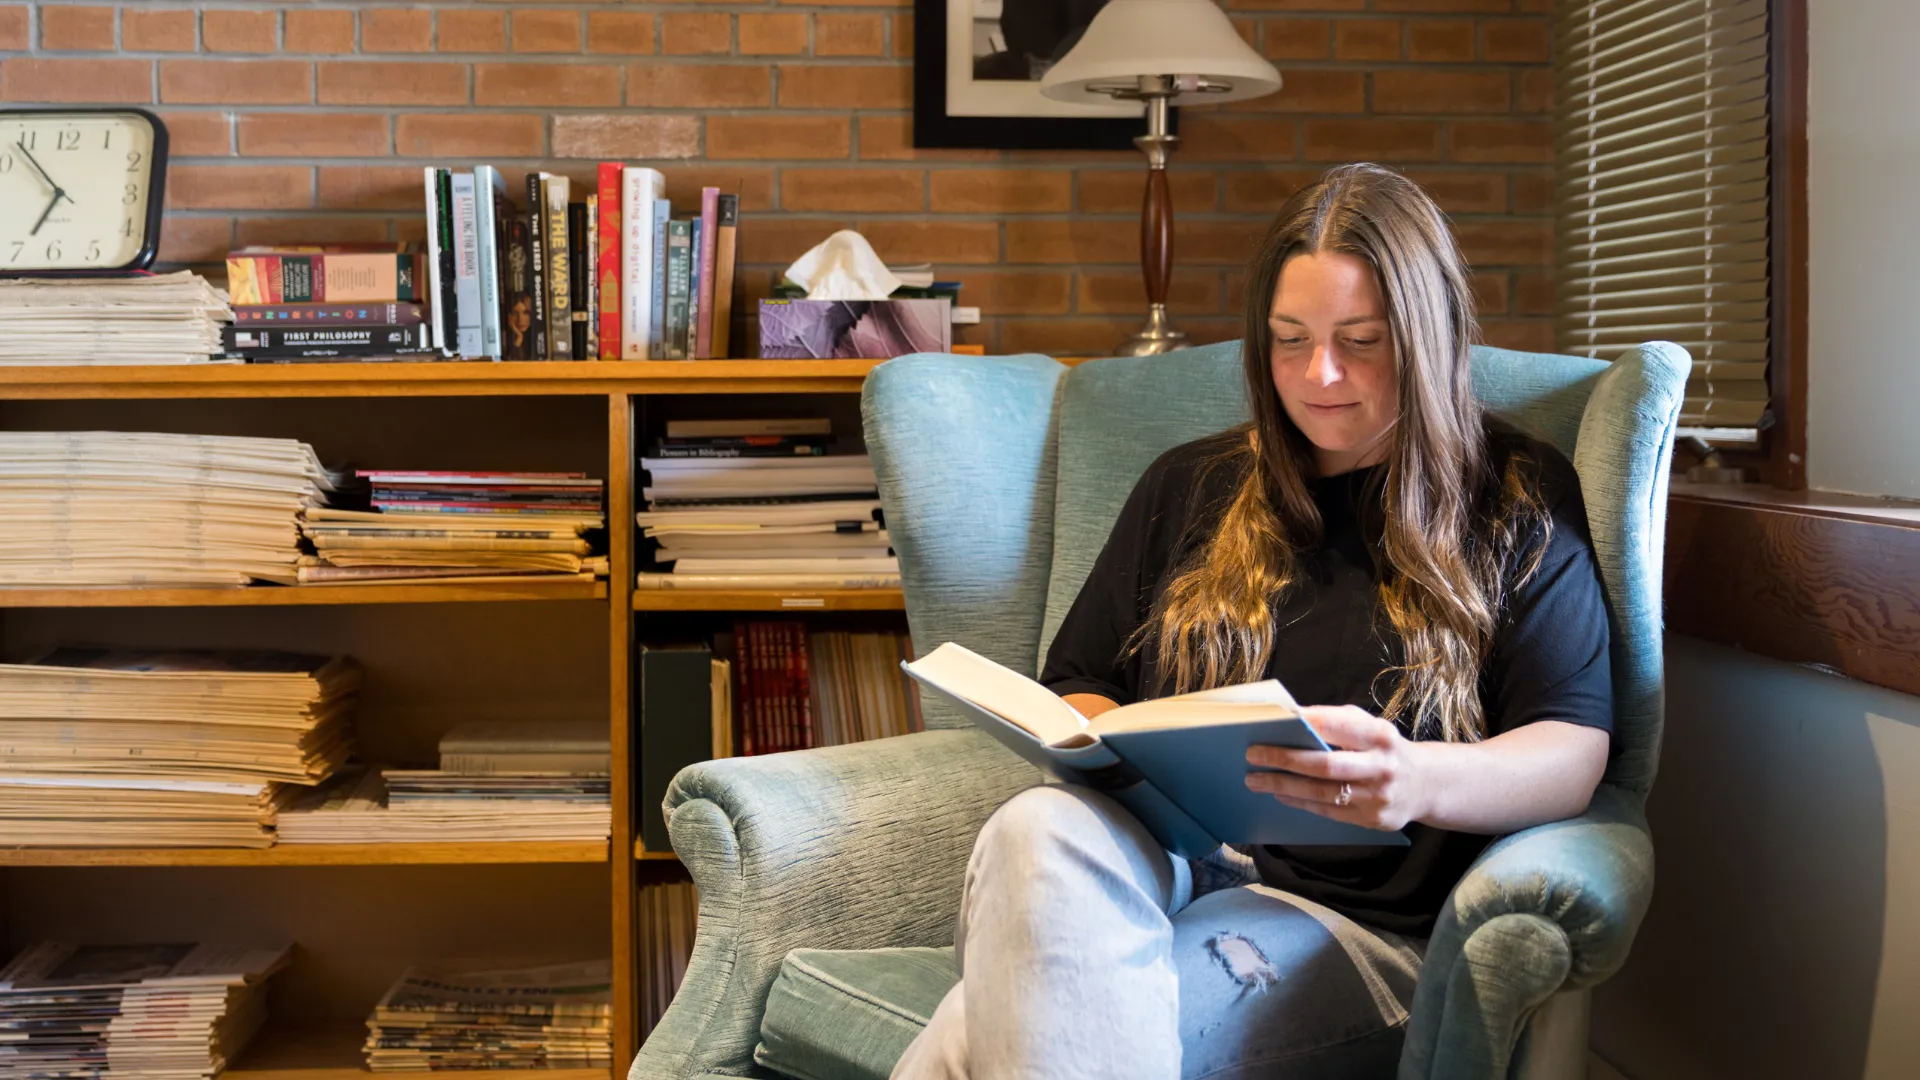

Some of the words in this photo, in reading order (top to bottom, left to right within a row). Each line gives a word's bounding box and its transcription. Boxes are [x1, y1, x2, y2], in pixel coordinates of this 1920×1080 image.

[20, 129, 36, 151] 11
[57, 129, 81, 151] 12
[103, 129, 111, 150] 1
[0, 153, 13, 174] 0
[126, 151, 141, 172] 2
[122, 183, 138, 205] 3
[630, 178, 642, 220] growing
[119, 217, 134, 237] 4
[531, 213, 540, 236] THE
[551, 211, 566, 248] THE
[630, 225, 640, 238] up
[11, 240, 25, 262] 7
[46, 240, 62, 262] 6
[85, 240, 100, 262] 5
[464, 235, 475, 249] FOR
[465, 251, 476, 277] BOOKS
[533, 240, 542, 271] WIRED
[630, 244, 642, 284] digital
[670, 258, 679, 296] GIBSON
[680, 248, 688, 291] WILLIAM
[553, 252, 569, 310] WARD
[534, 275, 543, 321] SOCIETY
[283, 331, 310, 341] FIRST
[313, 331, 372, 340] PHILOSOPHY
[660, 448, 689, 457] Pioneers
[690, 448, 697, 457] in
[698, 447, 741, 458] Bibliography
